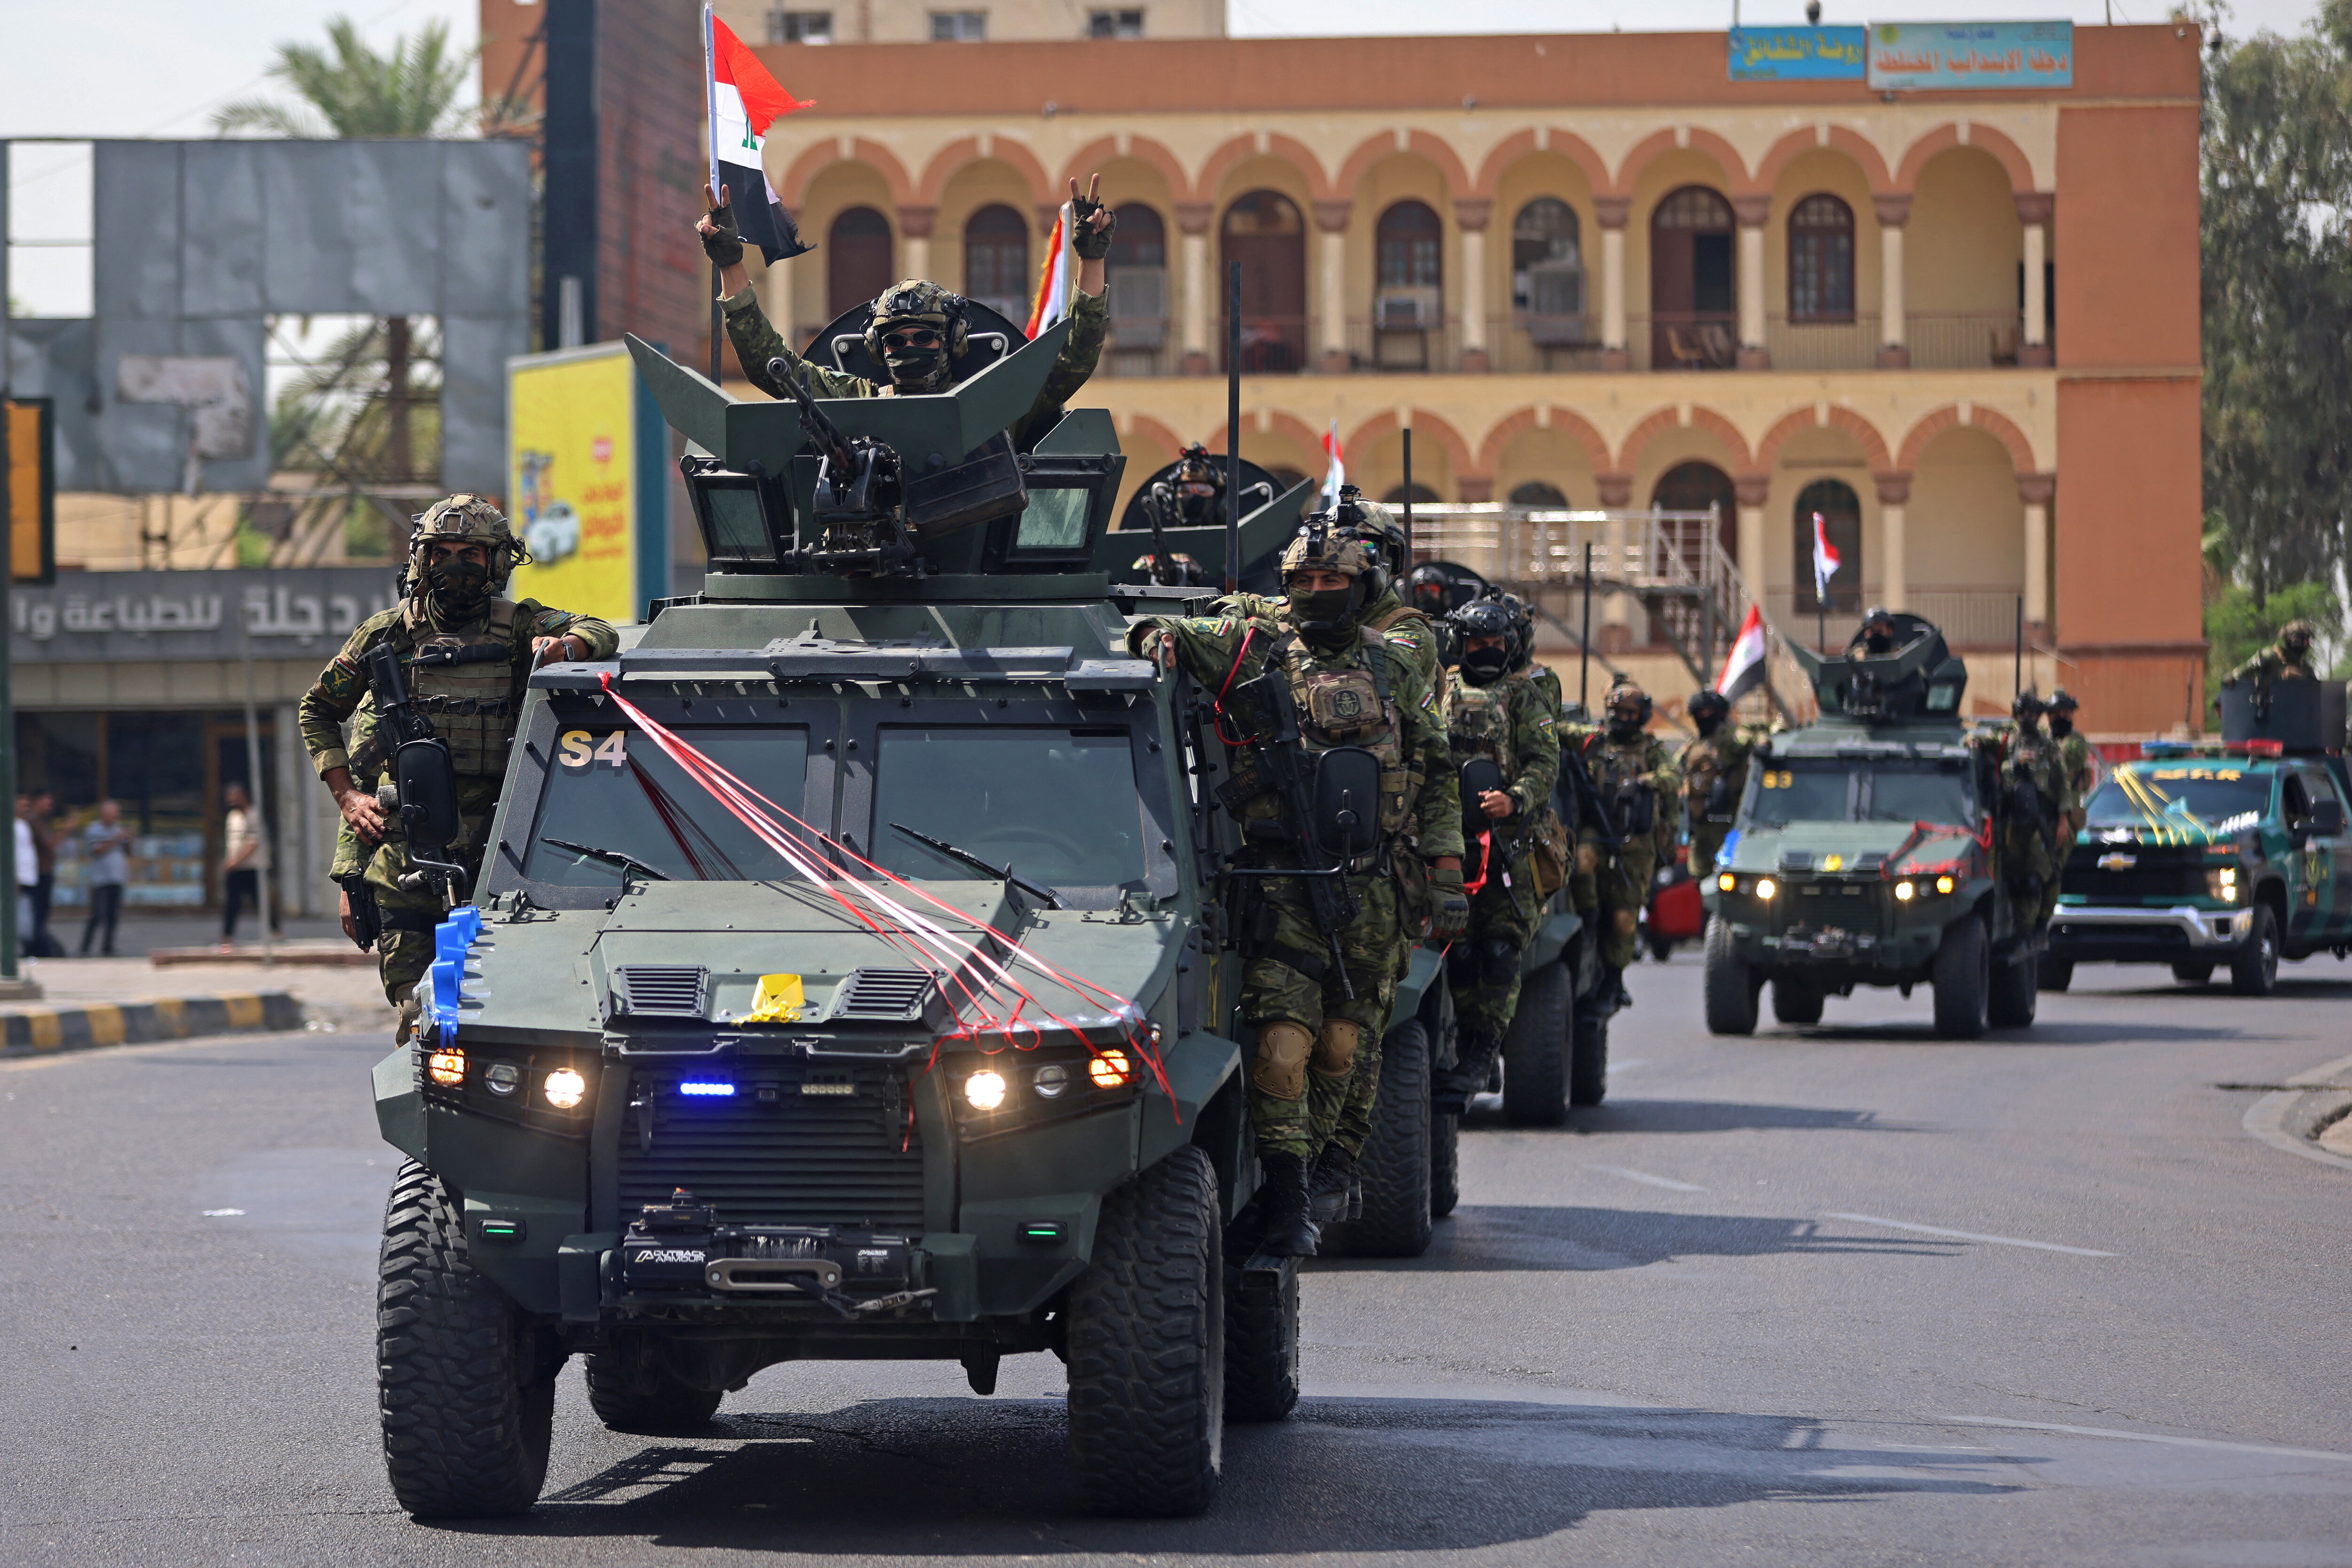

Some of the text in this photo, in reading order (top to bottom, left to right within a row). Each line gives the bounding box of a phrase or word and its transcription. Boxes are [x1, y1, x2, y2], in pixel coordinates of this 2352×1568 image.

[2028, 47, 2067, 77] دجلة
[62, 592, 222, 638] للطباعة
[246, 585, 359, 645] دجلة
[559, 730, 627, 767] S4
